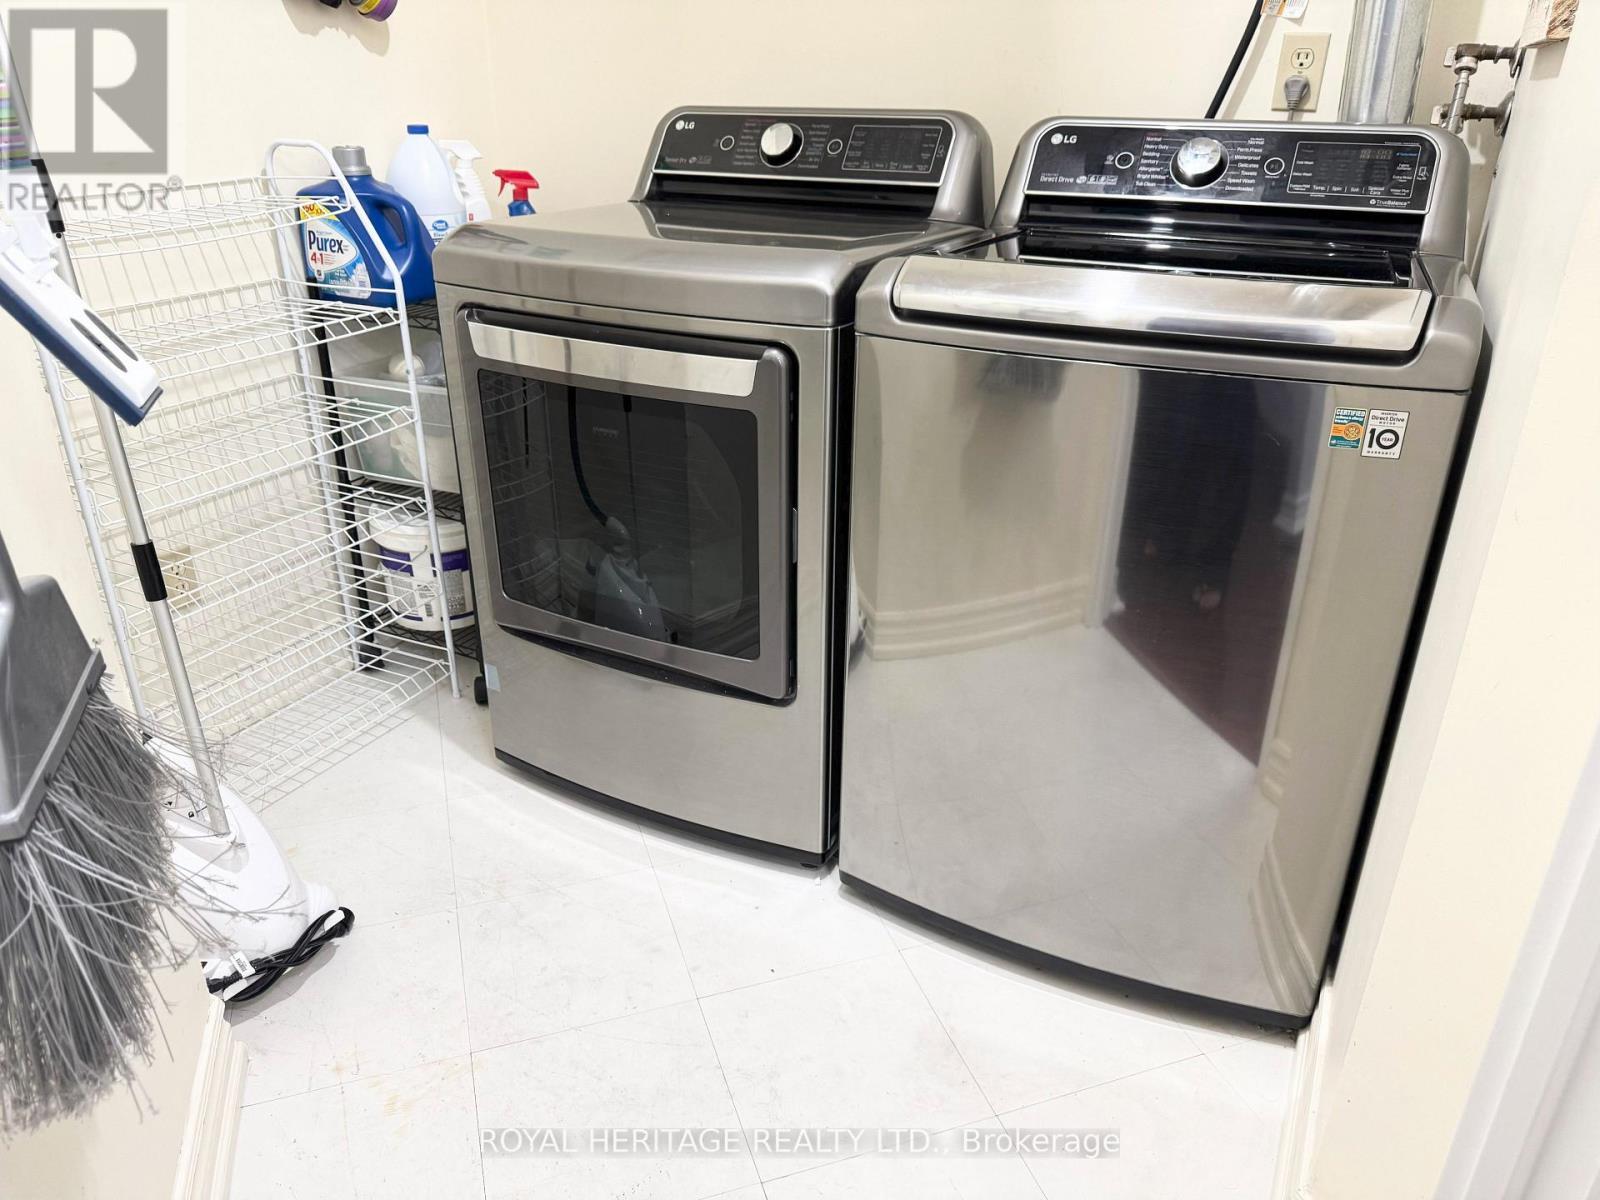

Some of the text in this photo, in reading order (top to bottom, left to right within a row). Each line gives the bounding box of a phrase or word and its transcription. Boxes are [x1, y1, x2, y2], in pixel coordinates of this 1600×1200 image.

[684, 121, 696, 130] LG
[1063, 135, 1078, 144] LG
[1040, 175, 1058, 183] Direct
[308, 230, 344, 254] Purex
[1367, 428, 1400, 450] 10
